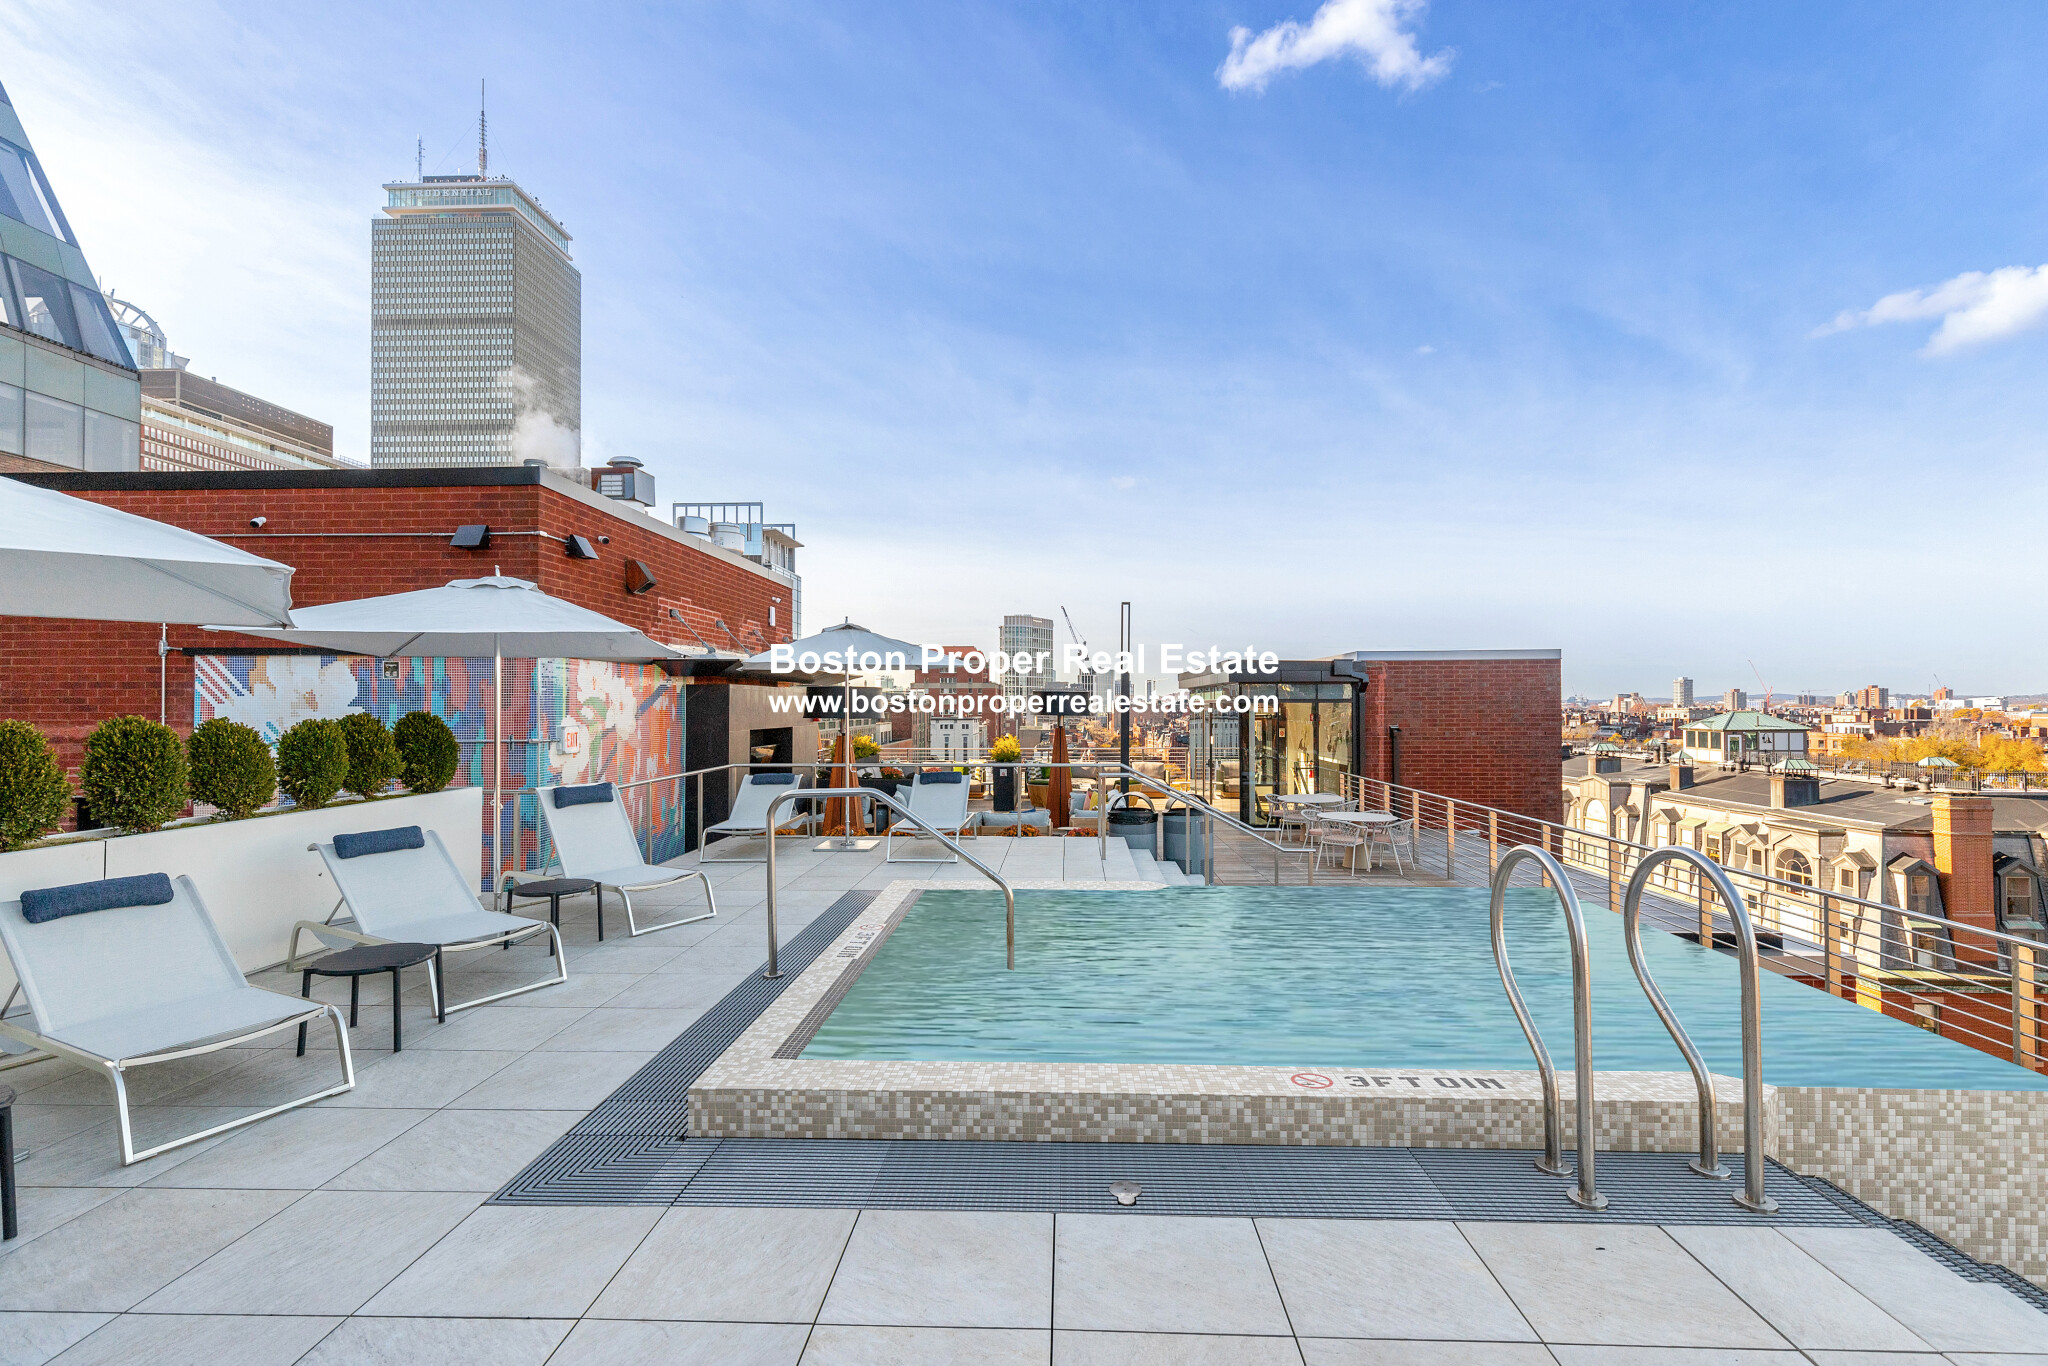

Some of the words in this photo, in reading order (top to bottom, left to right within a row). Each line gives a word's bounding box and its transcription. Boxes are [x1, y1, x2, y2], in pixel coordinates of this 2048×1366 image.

[407, 188, 492, 197] PRUDENTIAL
[566, 731, 578, 748] EXIT
[1344, 1075, 1421, 1088] 3FT
